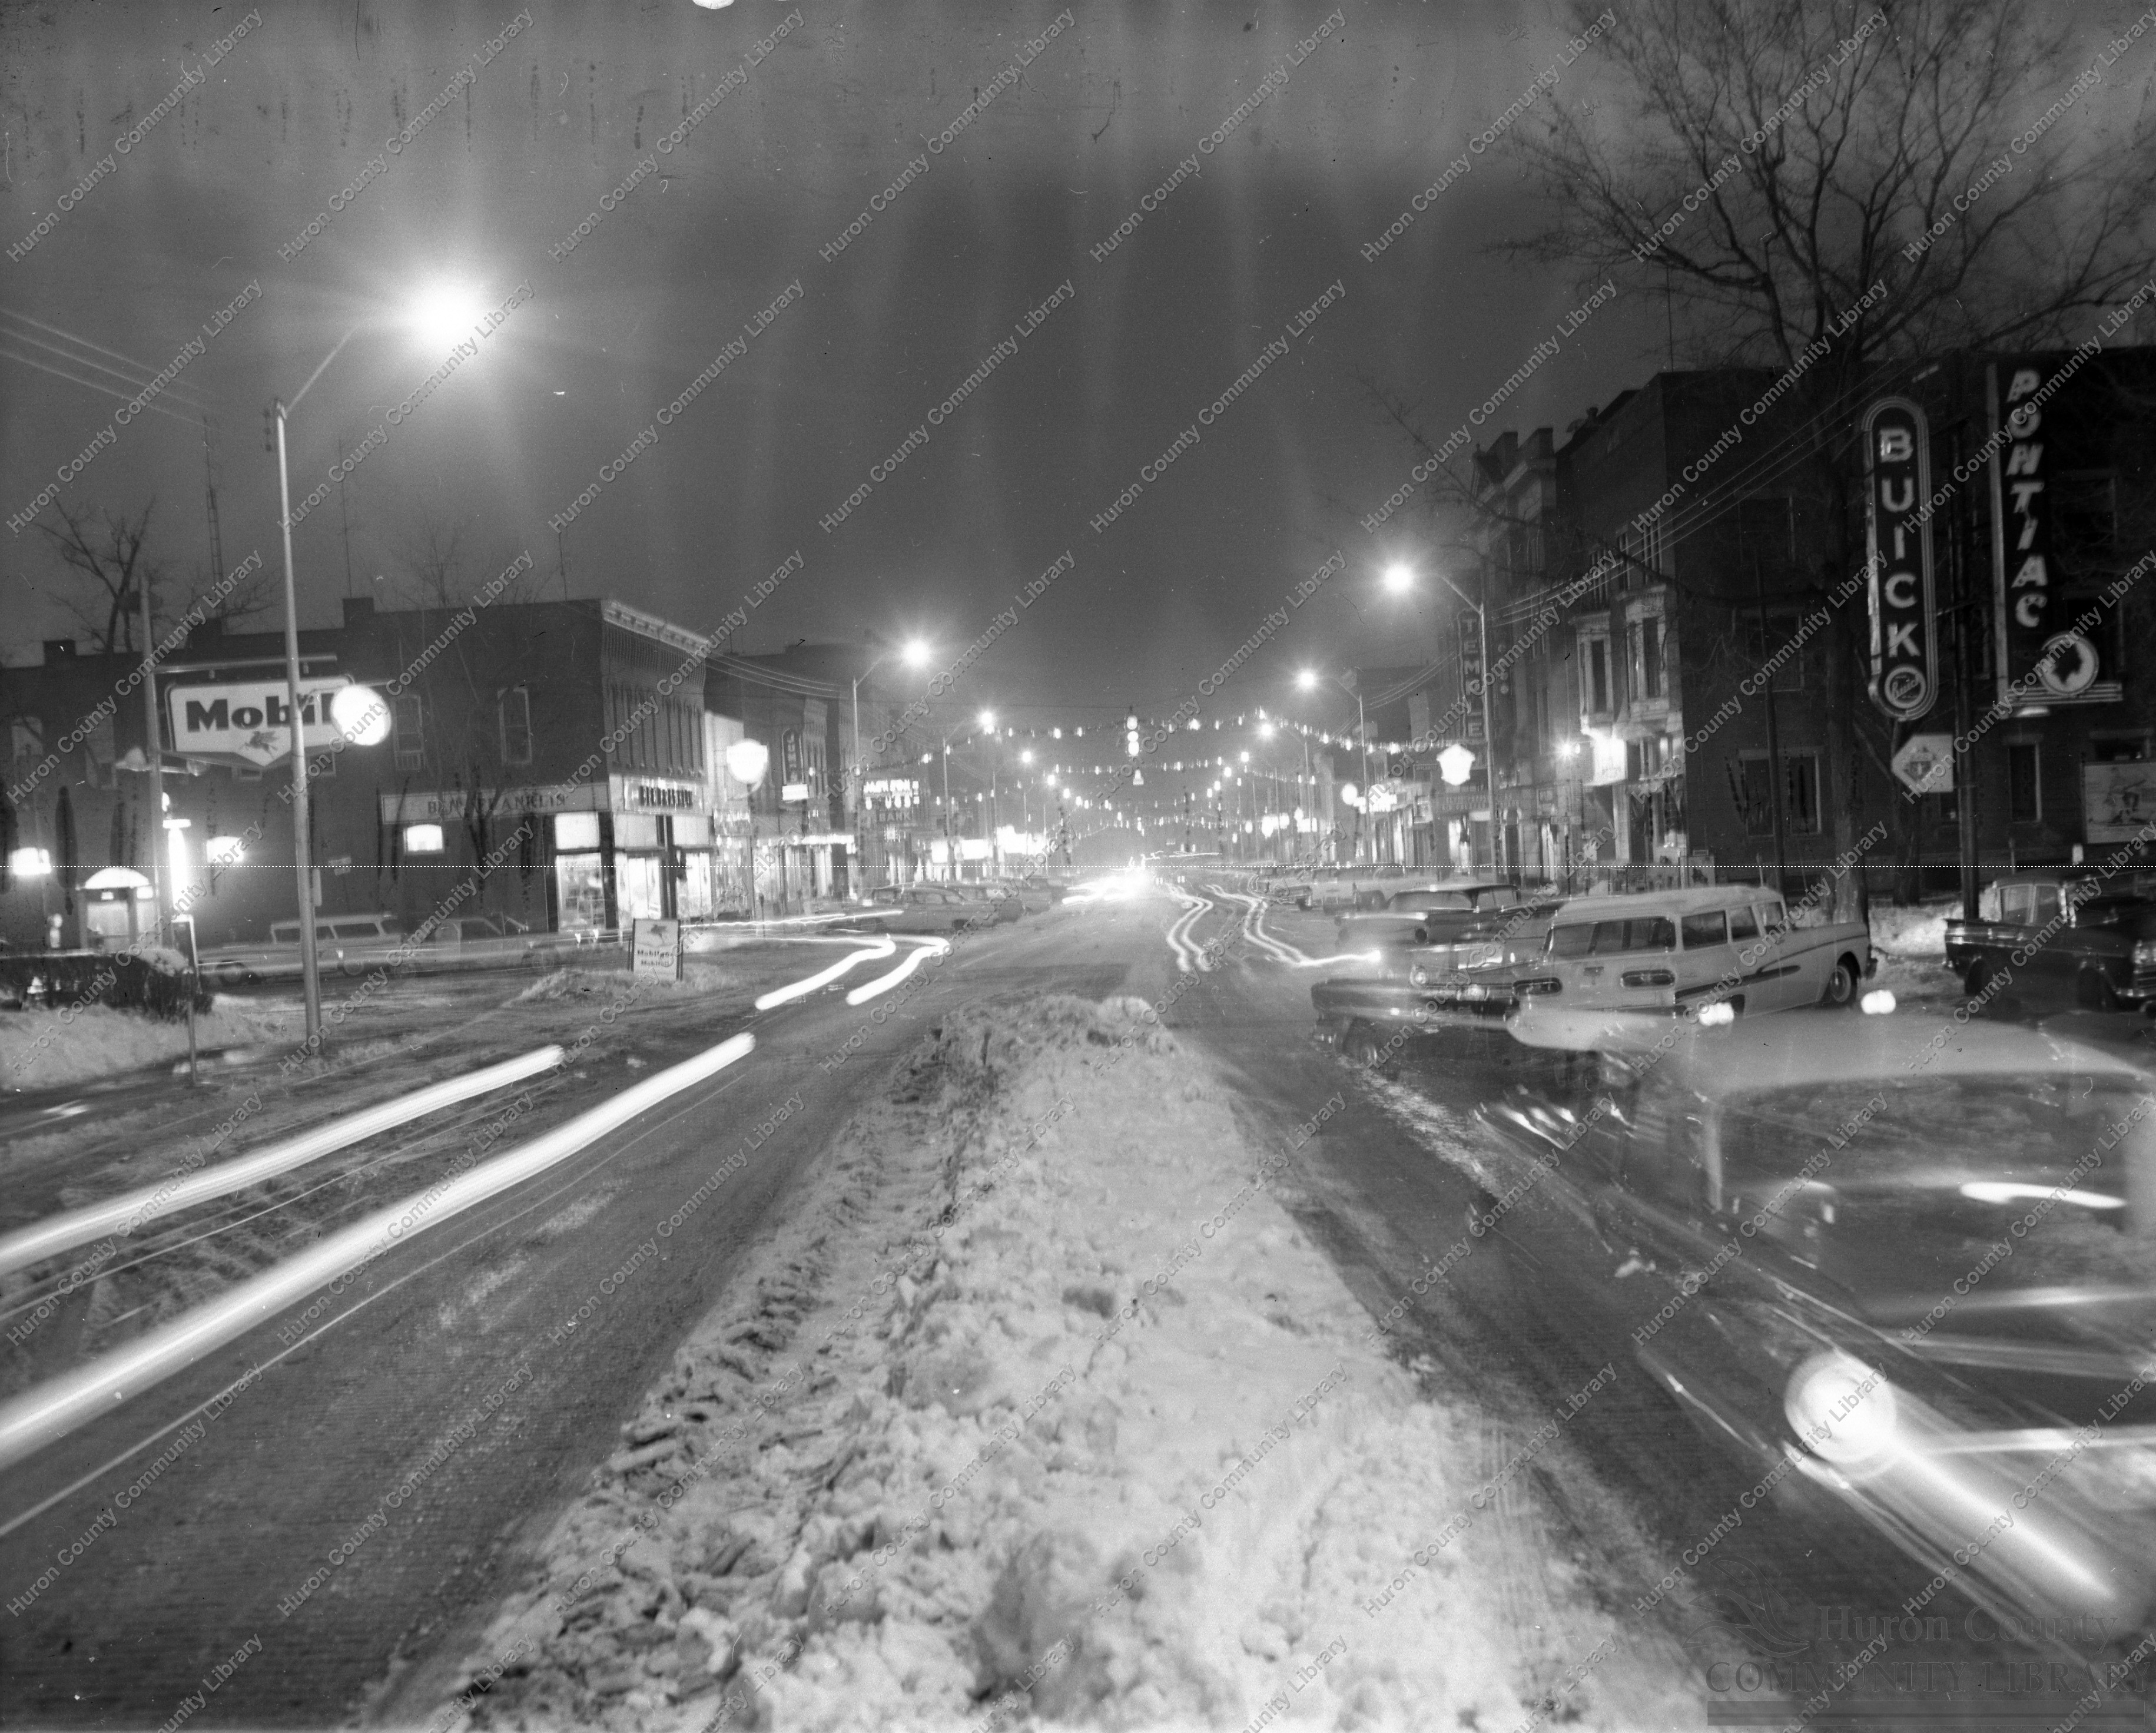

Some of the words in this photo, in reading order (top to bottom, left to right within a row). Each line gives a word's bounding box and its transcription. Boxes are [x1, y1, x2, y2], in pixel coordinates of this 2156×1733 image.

[2006, 369, 2048, 628] PONTIAC
[1880, 427, 1921, 658] BUICK
[186, 692, 334, 732] Mobil
[475, 793, 566, 814] ANKLIN
[878, 811, 911, 823] BANK
